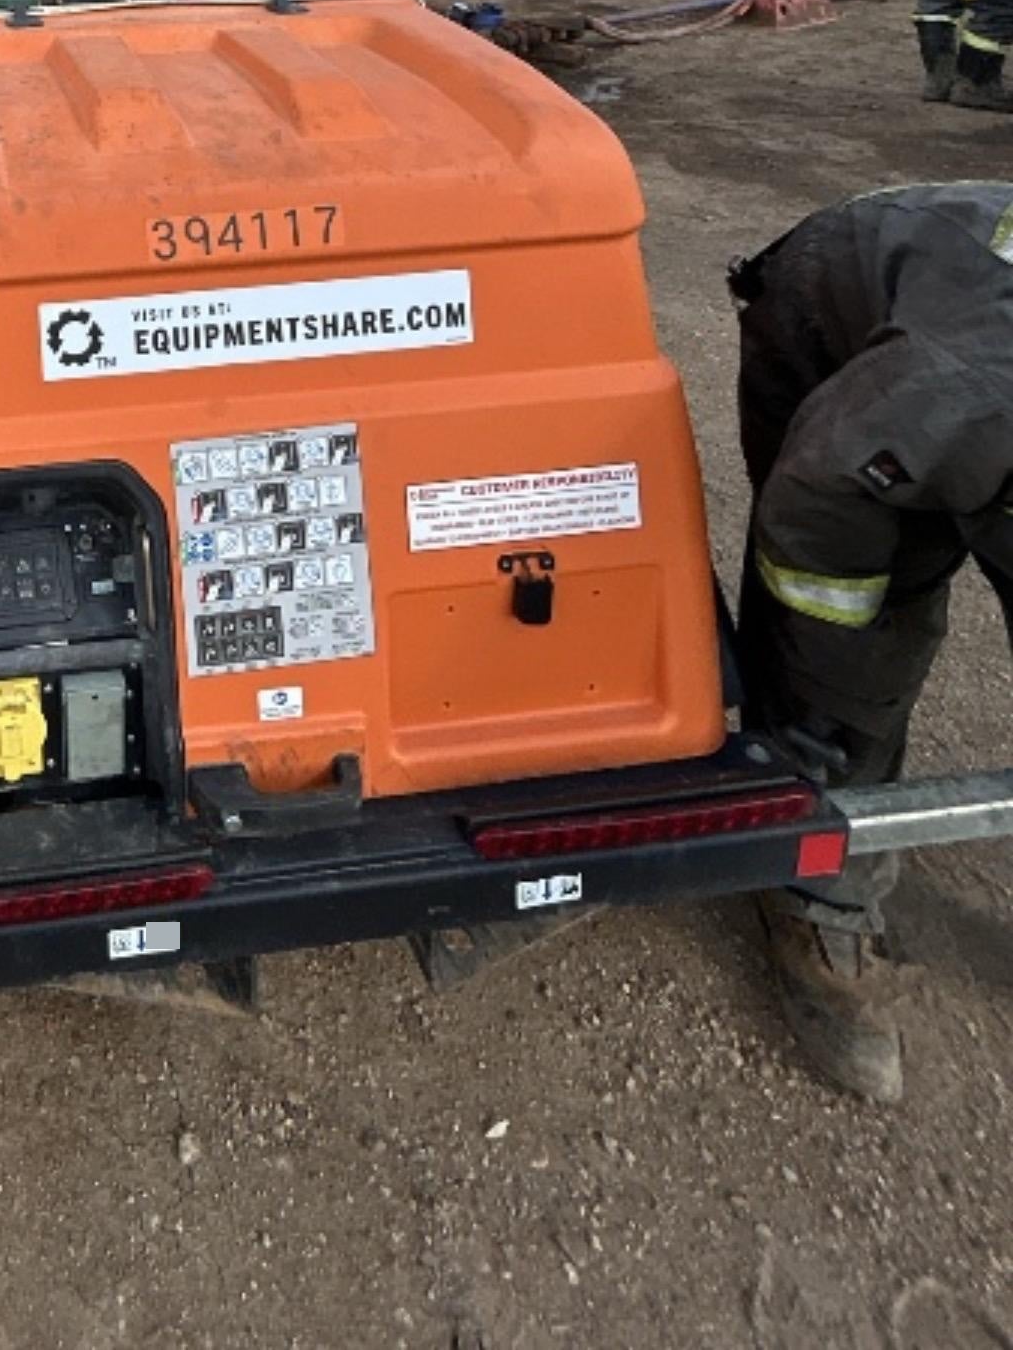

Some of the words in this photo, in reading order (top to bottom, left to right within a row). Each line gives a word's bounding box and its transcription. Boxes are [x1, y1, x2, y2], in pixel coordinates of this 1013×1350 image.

[150, 204, 338, 261] 394117
[132, 307, 174, 323] VISIT
[133, 302, 467, 355] EQUIPMENTSHARE.COM
